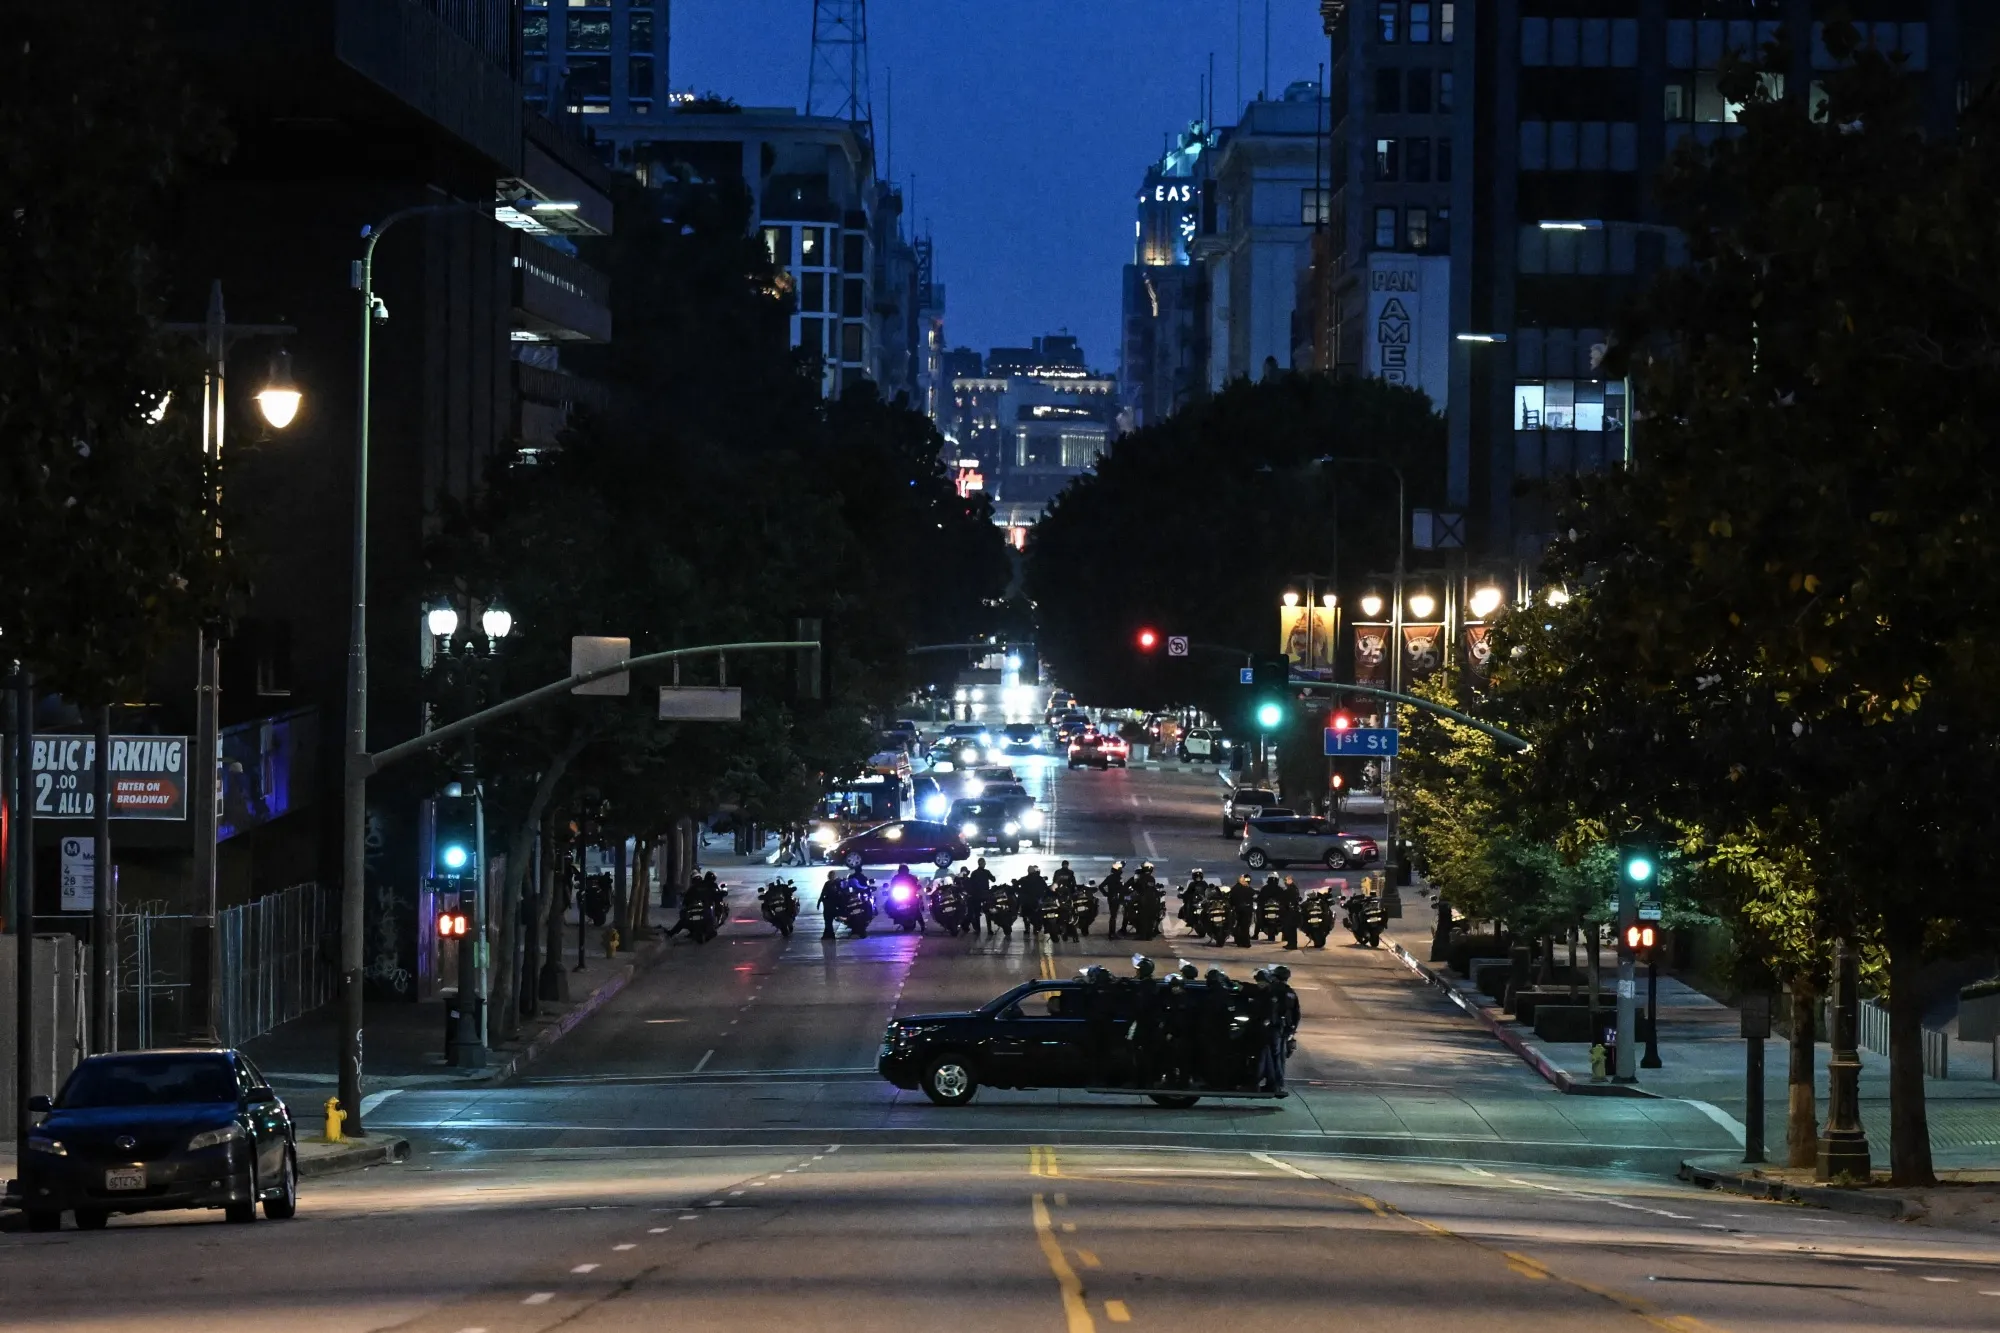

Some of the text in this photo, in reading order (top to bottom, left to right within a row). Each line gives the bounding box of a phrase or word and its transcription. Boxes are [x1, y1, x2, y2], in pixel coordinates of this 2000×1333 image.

[1155, 185, 1191, 201] EAS
[1373, 271, 1417, 291] PAN
[1405, 641, 1434, 668] 95
[1336, 733, 1388, 750] 1st St
[31, 740, 81, 771] BLIC
[117, 782, 160, 791] ENTER ON
[59, 793, 82, 813] ALL
[117, 795, 169, 804] BROADWAY
[63, 876, 76, 886] 28
[63, 887, 76, 896] 45
